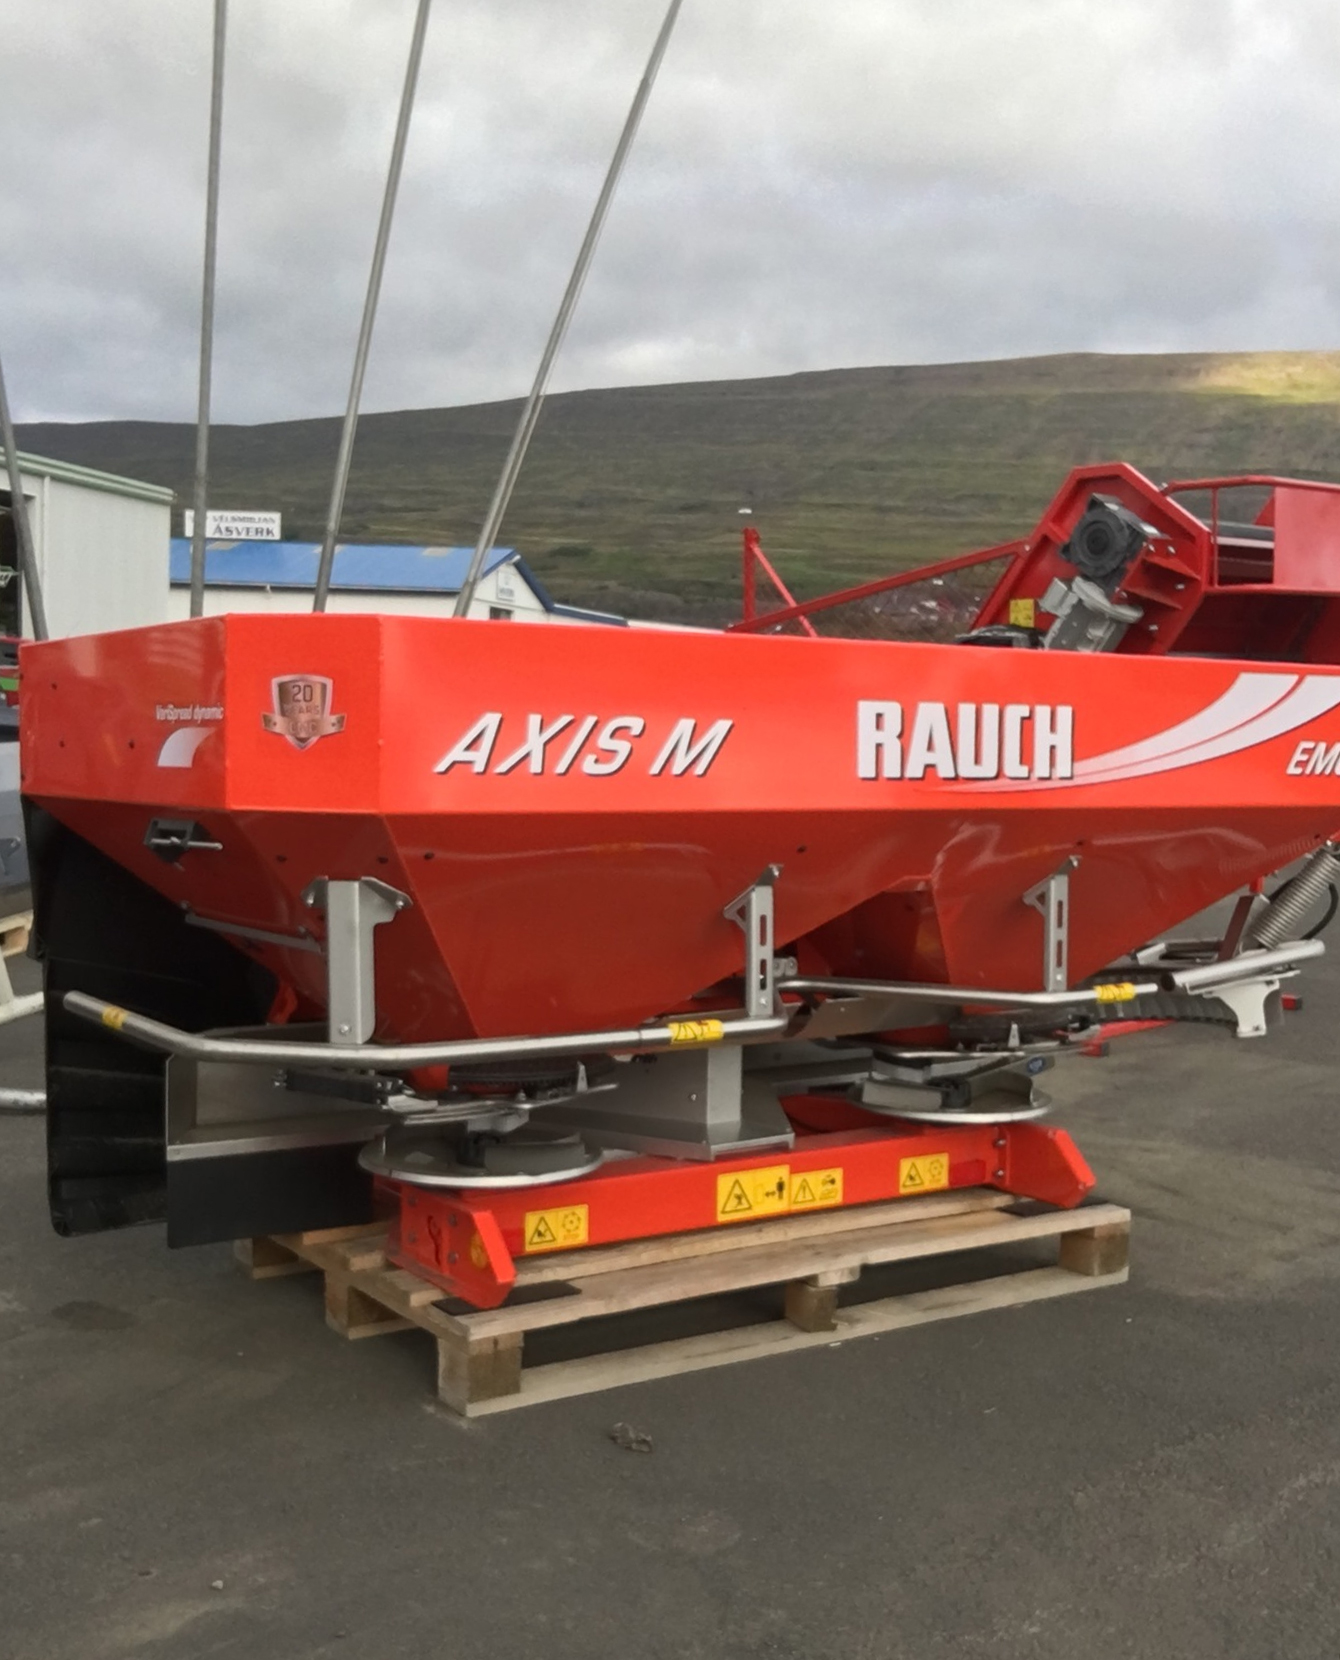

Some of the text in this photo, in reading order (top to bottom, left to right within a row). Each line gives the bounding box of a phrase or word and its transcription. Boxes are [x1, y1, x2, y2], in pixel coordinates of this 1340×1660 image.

[212, 524, 275, 538] ÁSVERK
[292, 685, 313, 703] 20
[432, 712, 734, 777] AXIS M
[857, 699, 1075, 780] RAUCH
[1285, 740, 1340, 776] EM
